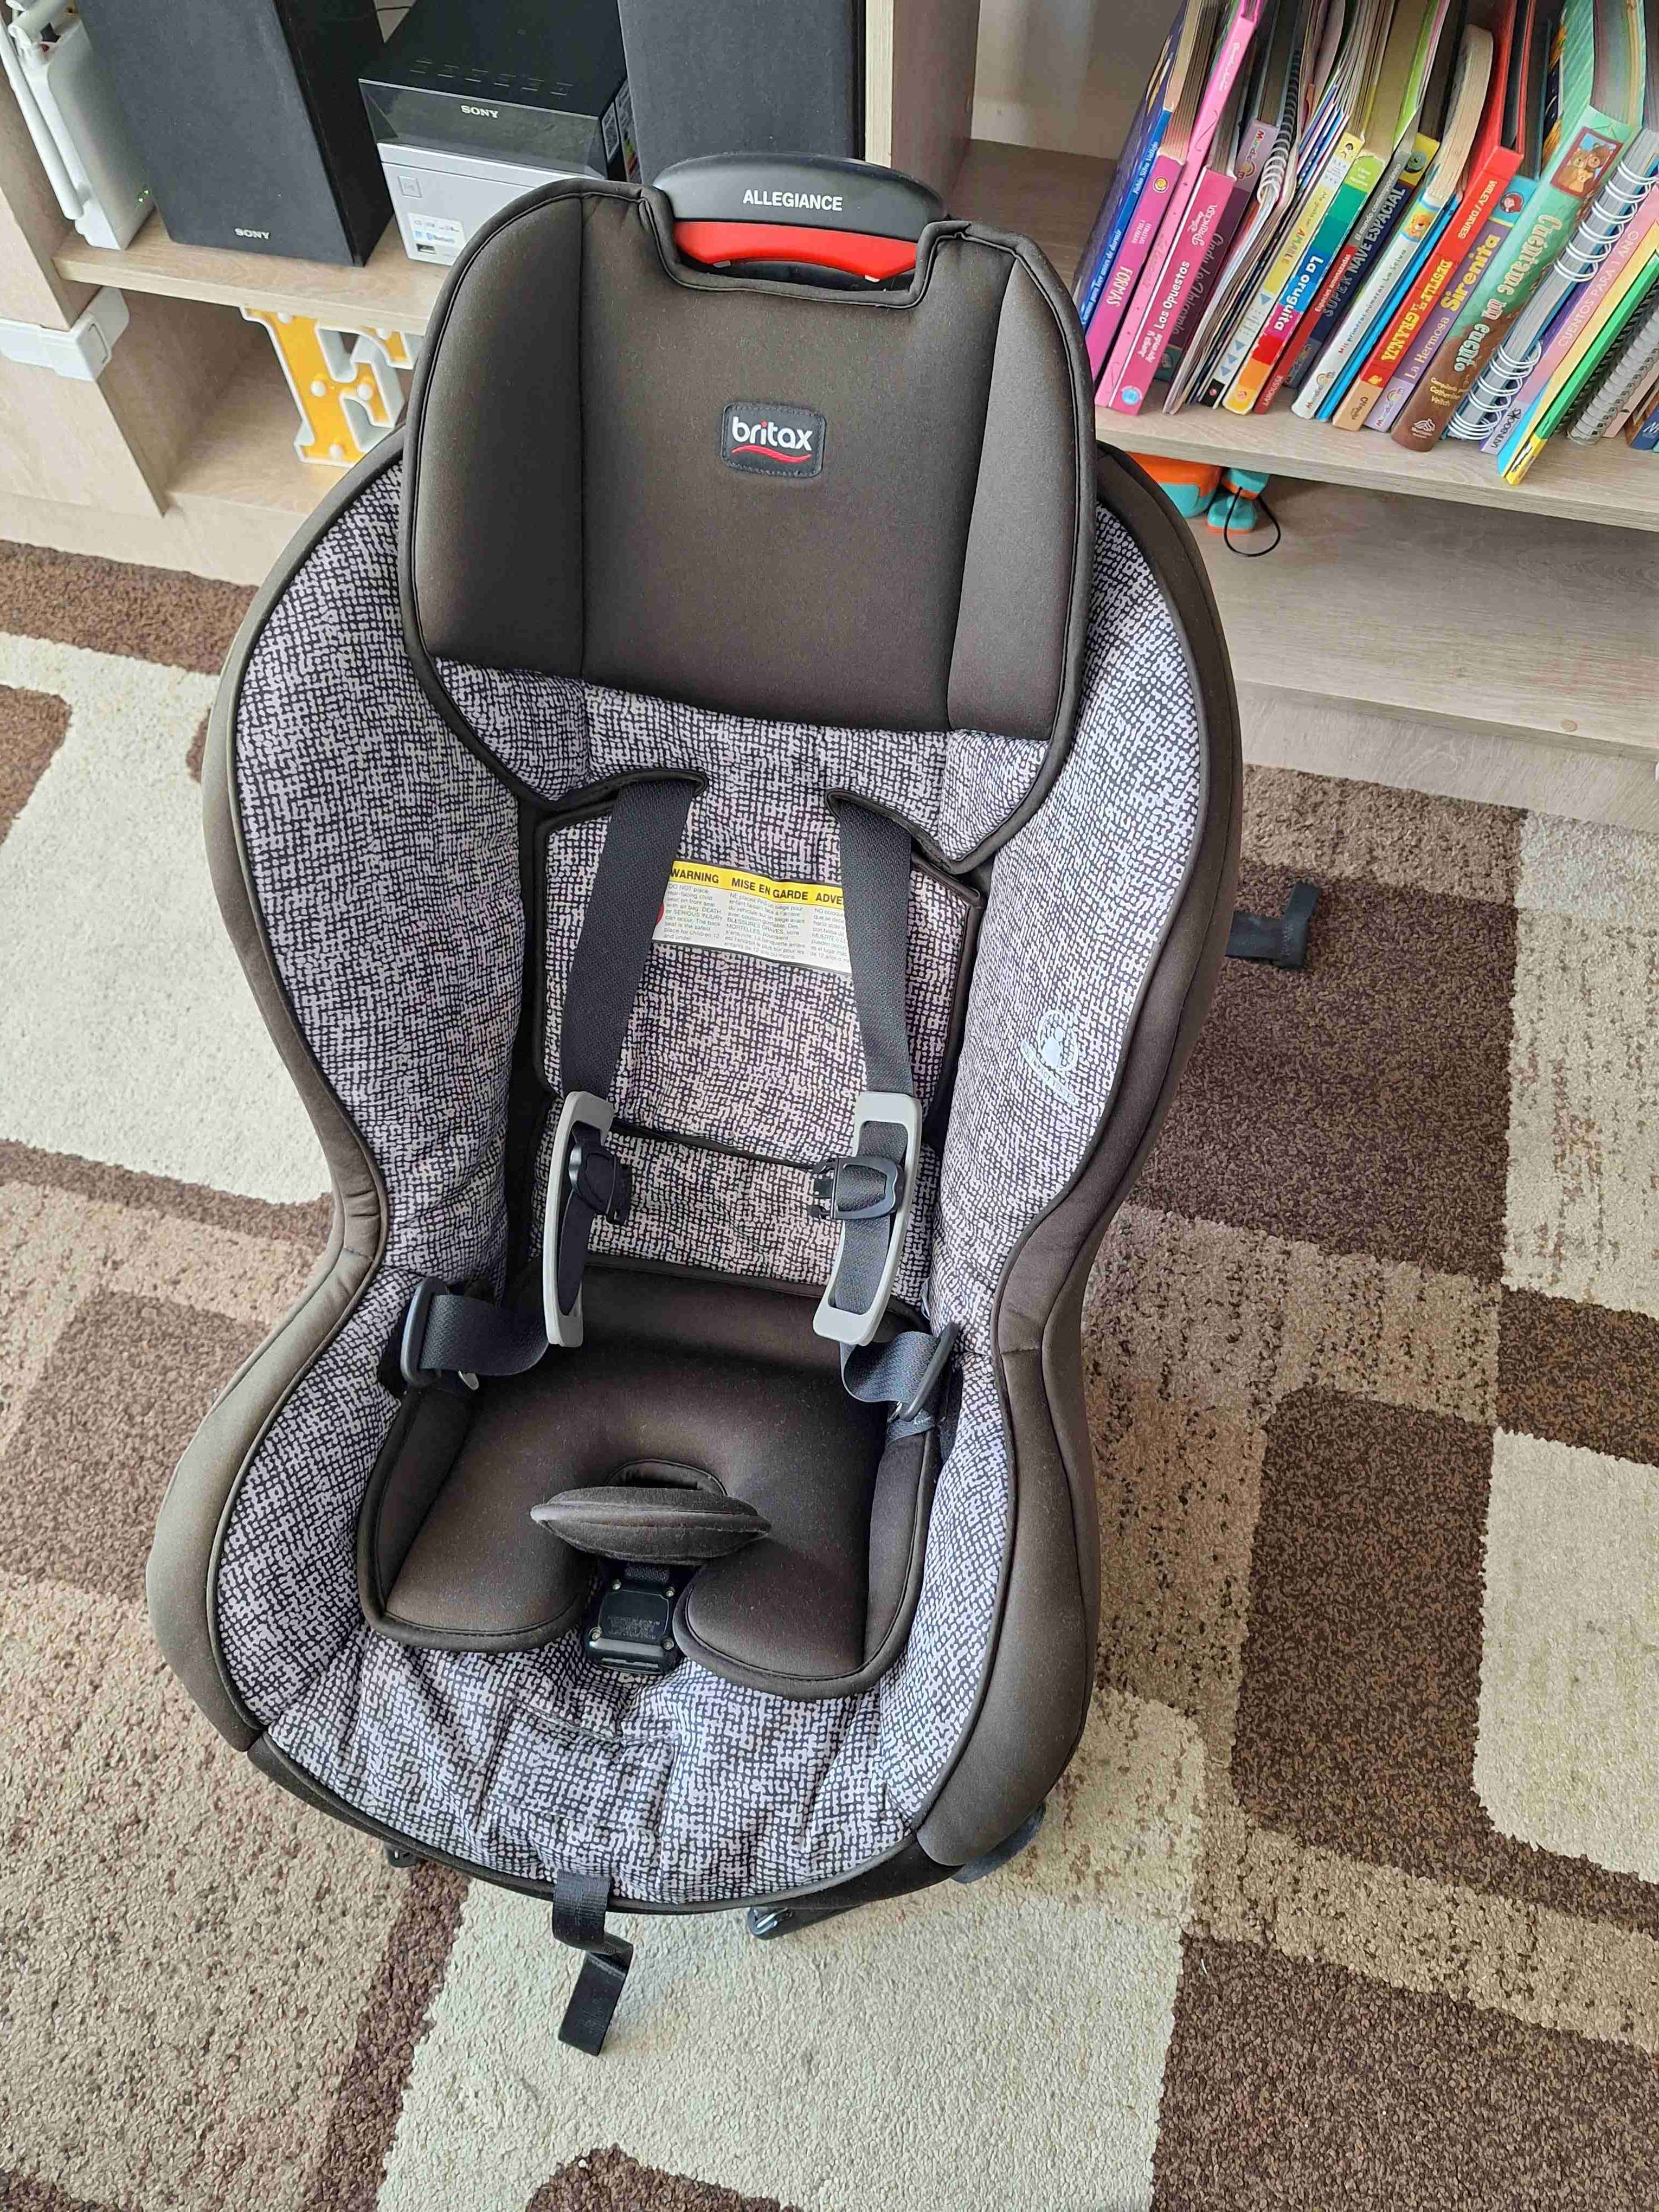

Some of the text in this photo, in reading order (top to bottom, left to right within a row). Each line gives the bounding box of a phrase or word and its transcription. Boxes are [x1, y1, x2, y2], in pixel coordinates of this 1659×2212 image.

[461, 105, 498, 118] SONY
[1138, 161, 1152, 178] Silva
[743, 189, 843, 211] ALLEGIANCE
[235, 228, 269, 239] SONY
[1357, 211, 1374, 234] mundo
[1458, 210, 1479, 239] DAVIES
[1107, 227, 1123, 251] dormir
[1322, 183, 1406, 318] SUPER NAVE ESPACIAL
[1306, 255, 1324, 272] La
[1382, 272, 1392, 282] La
[1389, 249, 1407, 272] Selva
[1107, 266, 1133, 306] FORMAS
[1154, 310, 1169, 329] Los
[1163, 261, 1191, 309] Opuestos
[1314, 252, 1352, 313] Especies amenazadas
[1454, 214, 1562, 372] Cuéntame un cuento
[1274, 275, 1310, 331] oruguita
[1405, 234, 1501, 380] La Hermosa Sirenita
[1558, 299, 1594, 347] CUENTOS
[1590, 269, 1615, 297] PARA
[1146, 333, 1163, 363] Aprende
[1381, 312, 1420, 361] GRANJA
[1263, 376, 1283, 407] LAROUSSE
[732, 416, 813, 451] britax
[671, 869, 719, 883] WARNING
[731, 878, 808, 900] MISE EN GARDE
[815, 892, 844, 904] ADVE
